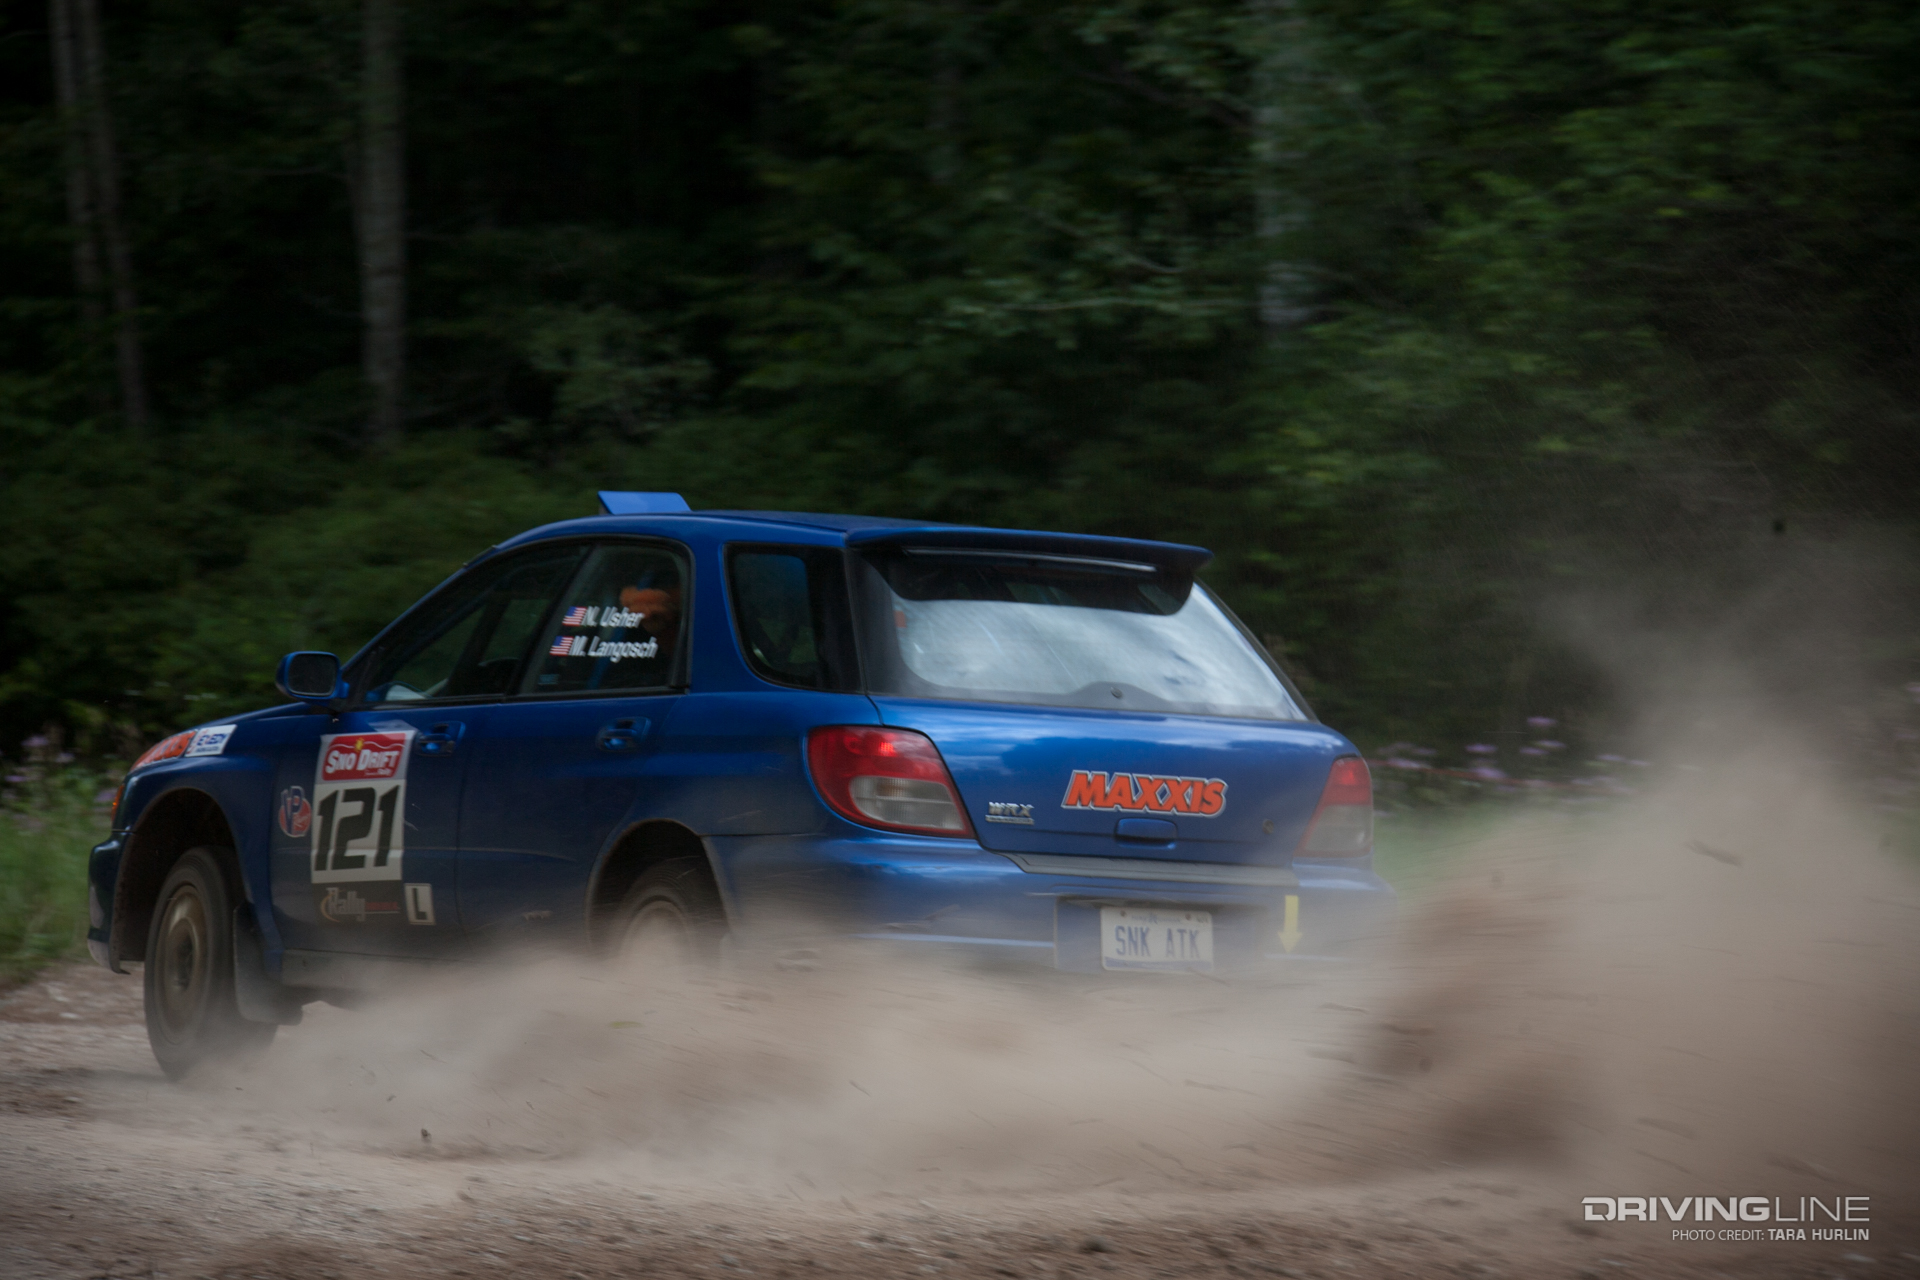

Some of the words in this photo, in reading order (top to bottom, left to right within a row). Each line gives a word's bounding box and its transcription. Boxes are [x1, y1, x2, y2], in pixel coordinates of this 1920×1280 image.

[580, 606, 600, 627] N.
[600, 606, 645, 628] Usher
[568, 635, 588, 657] M.
[587, 635, 659, 664] Langosch
[988, 801, 1035, 817] WRX
[1061, 769, 1229, 819] MAXXIS
[314, 785, 401, 871] 121
[413, 887, 428, 920] L
[1114, 925, 1152, 957] SNK
[1166, 927, 1200, 959] ATK
